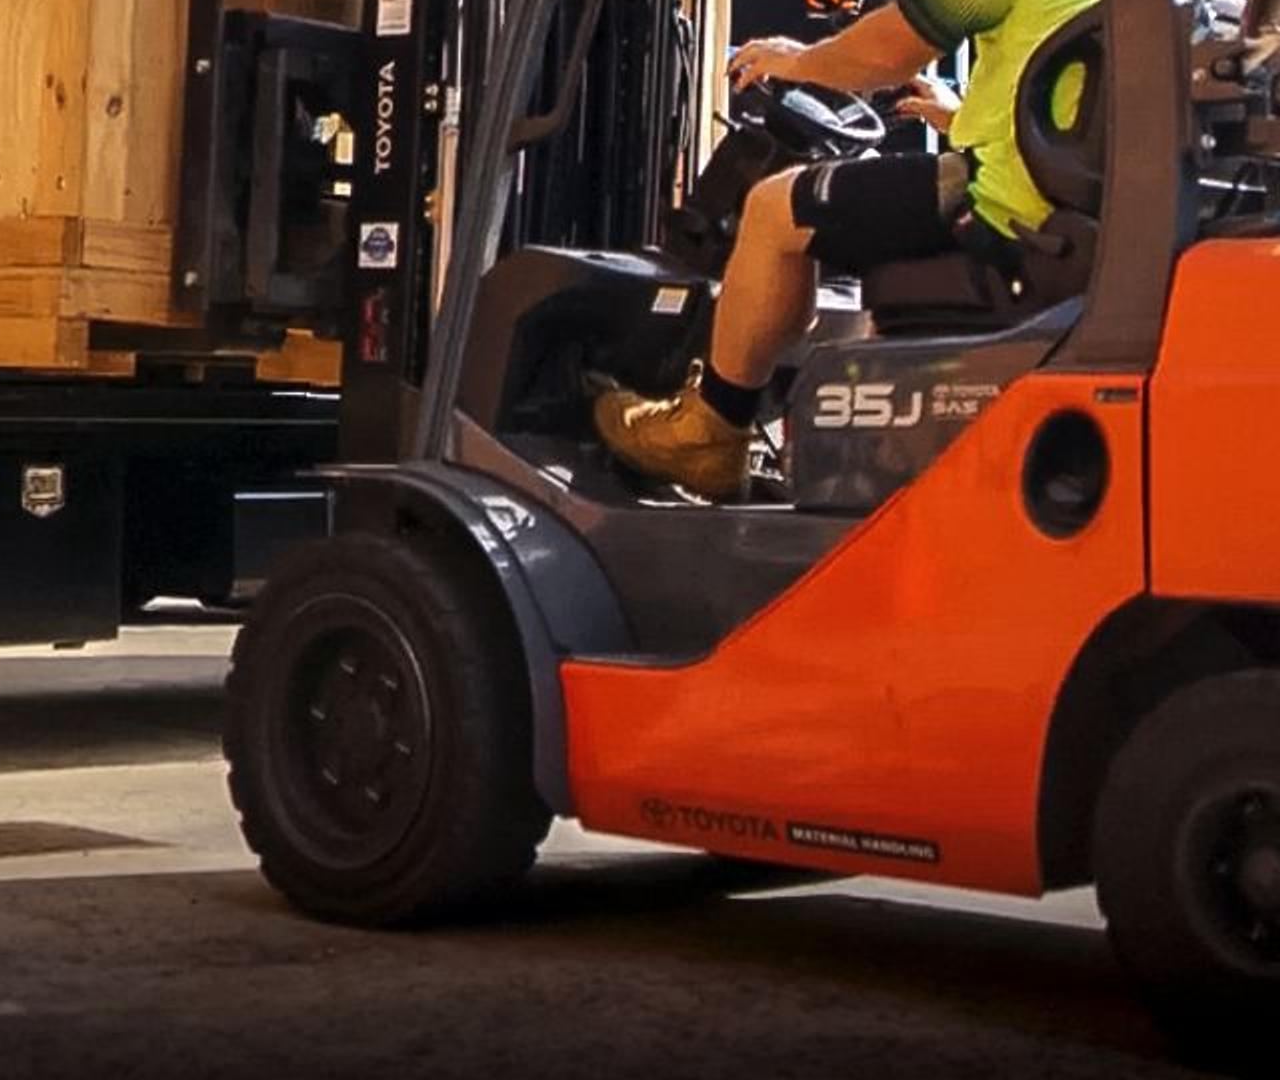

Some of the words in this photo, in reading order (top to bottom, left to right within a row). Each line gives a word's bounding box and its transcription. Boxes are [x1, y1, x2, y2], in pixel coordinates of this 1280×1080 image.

[375, 60, 396, 174] TOYOTA
[814, 383, 923, 427] 35J
[677, 806, 776, 840] TOYOTA
[792, 825, 857, 848] MATERIAL
[860, 835, 935, 860] HANDLING
